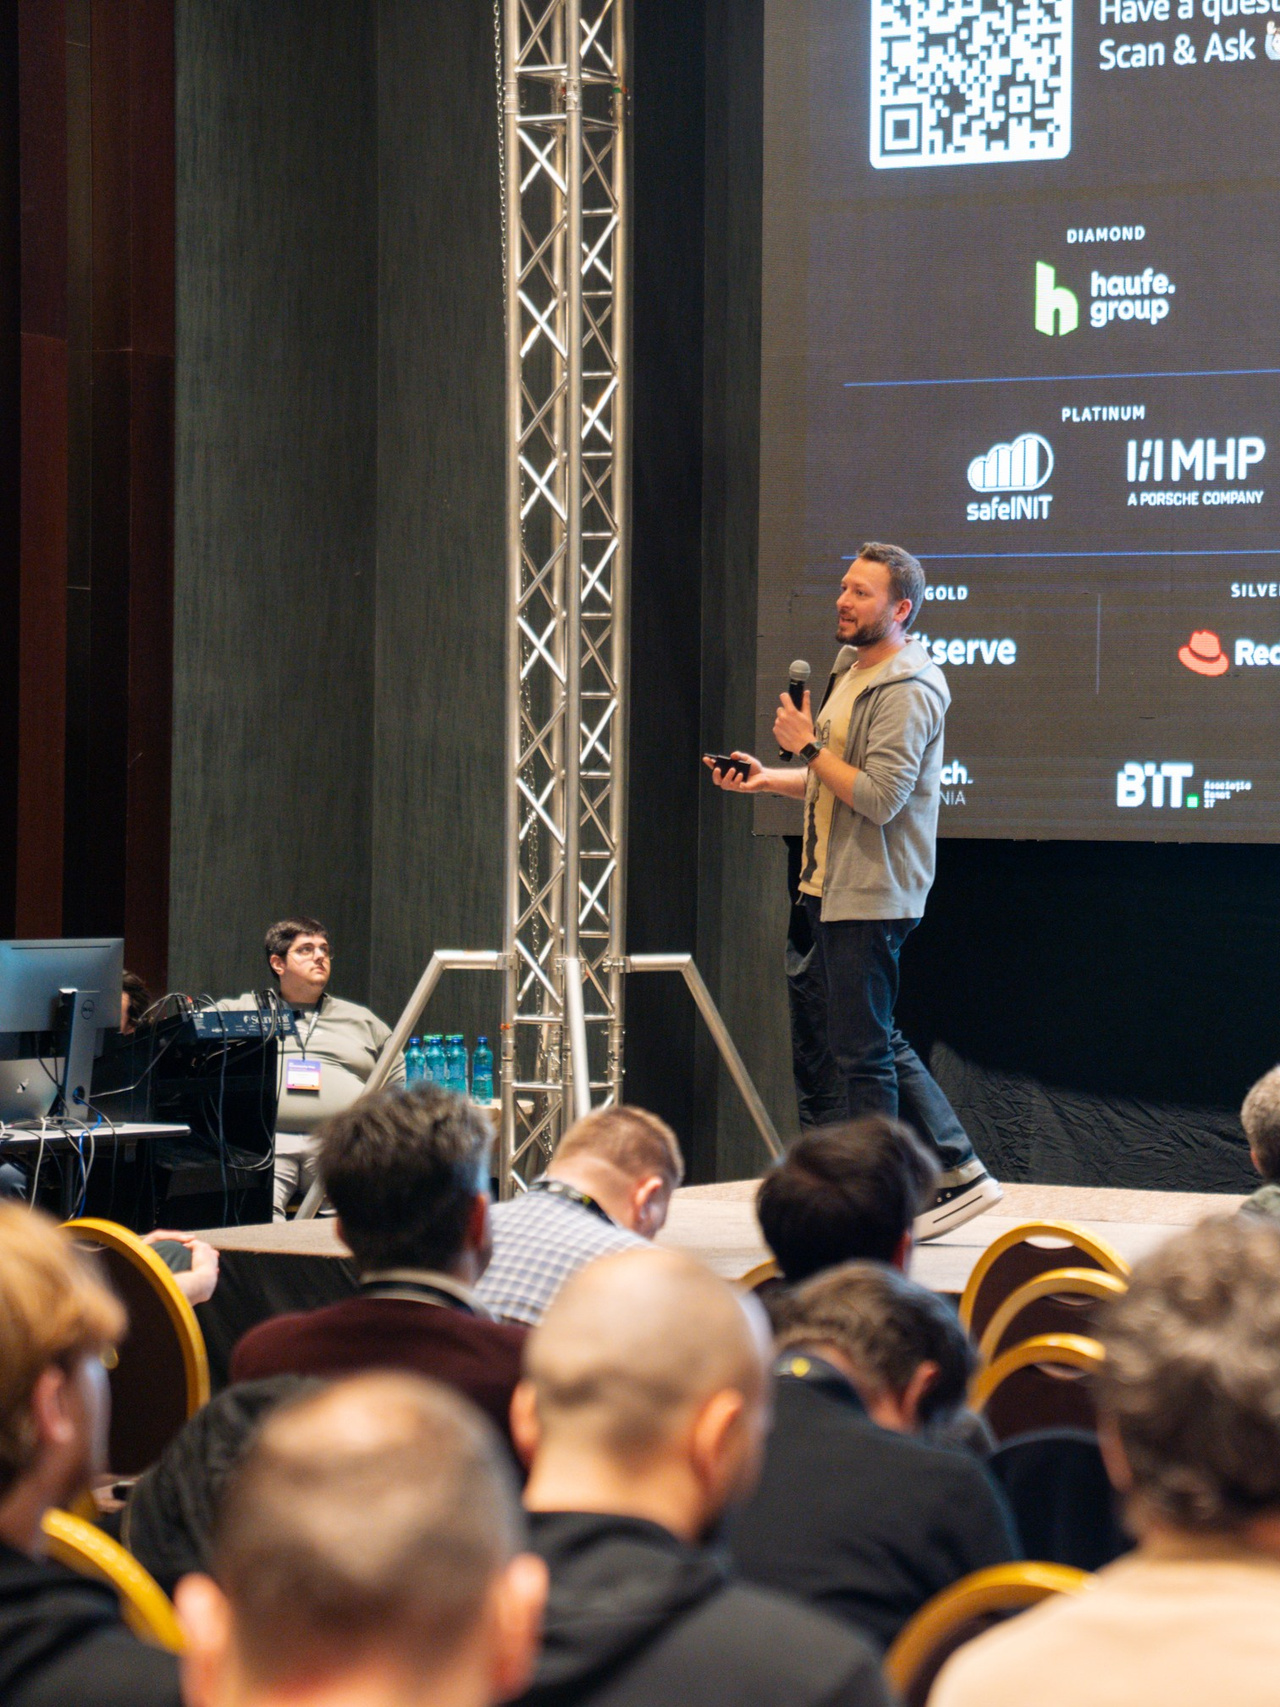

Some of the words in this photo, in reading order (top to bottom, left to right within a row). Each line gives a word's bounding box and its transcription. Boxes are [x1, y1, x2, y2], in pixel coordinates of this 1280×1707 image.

[1099, 0, 1170, 25] Have
[1177, 0, 1194, 19] a
[1098, 38, 1166, 71] Scan
[1172, 33, 1198, 66] &
[1203, 28, 1257, 64] Ask
[1066, 225, 1146, 244] DIAMOND
[1090, 267, 1176, 297] haufe.
[1090, 298, 1169, 327] group
[1061, 404, 1146, 422] PLATINUM
[1170, 436, 1267, 482] MHP
[966, 494, 1054, 521] safeINIT
[1126, 491, 1138, 507] A
[1139, 490, 1200, 507] PORSCHE
[1202, 489, 1265, 506] COMPANY
[924, 585, 969, 601] GOLD
[912, 631, 1018, 666] tserve
